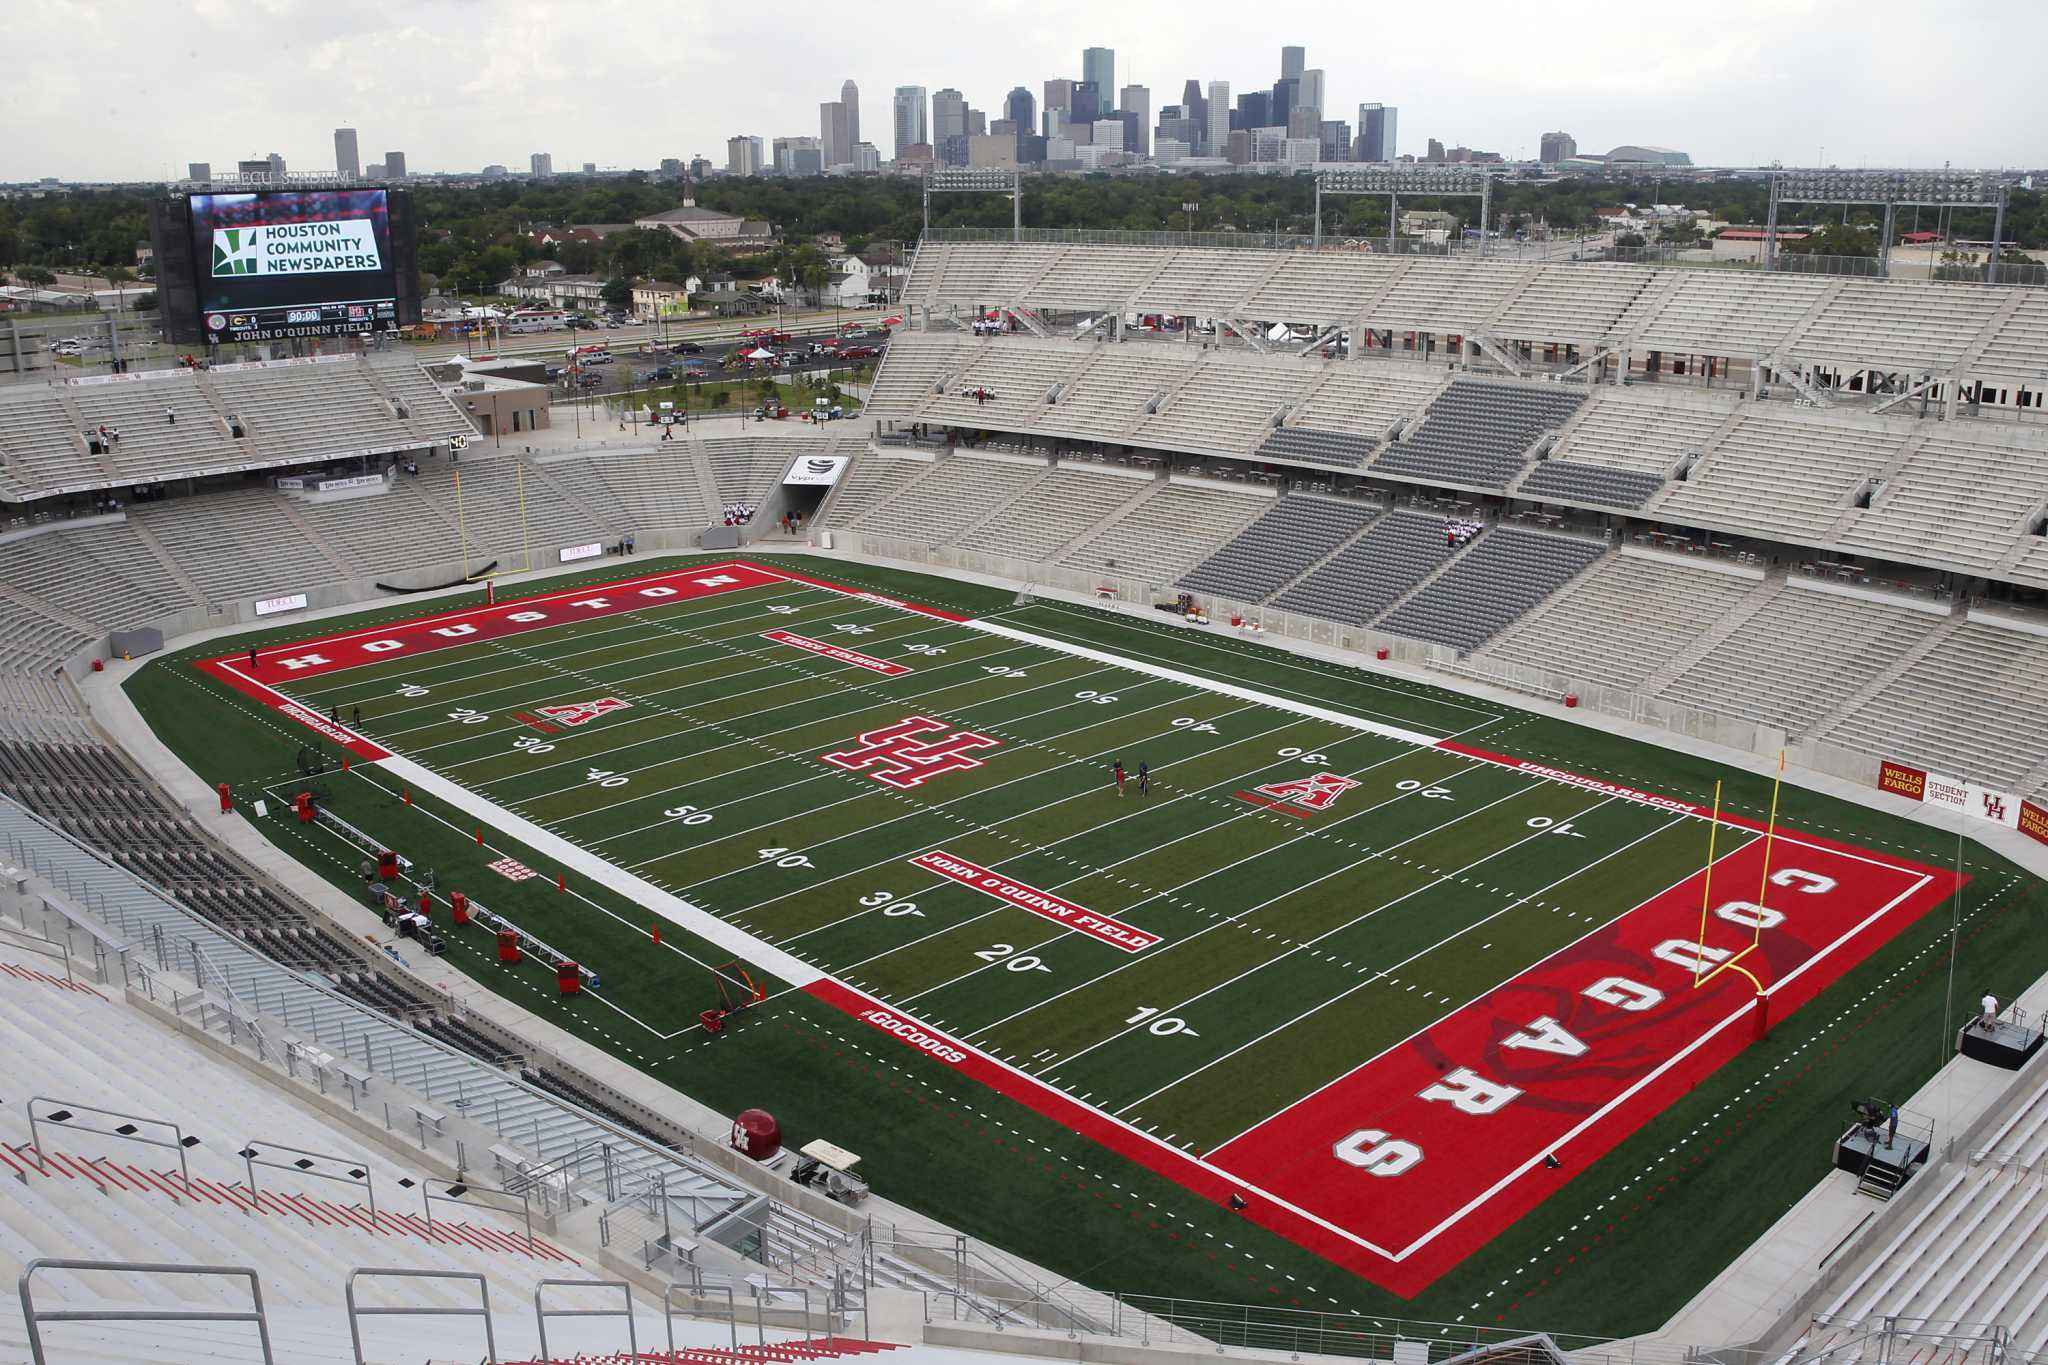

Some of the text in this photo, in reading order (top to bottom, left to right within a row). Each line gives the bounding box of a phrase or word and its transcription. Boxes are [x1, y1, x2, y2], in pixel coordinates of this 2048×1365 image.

[265, 223, 341, 240] HOUSTON
[266, 238, 362, 255] COMMUNITY
[267, 254, 377, 272] NEWSPAPERS
[289, 310, 318, 324] 90:00
[234, 322, 373, 341] JOHN O'QUINN FIELD
[450, 434, 467, 449] 40
[276, 574, 741, 670] HOUSTON
[909, 644, 947, 656] 30
[825, 649, 891, 670] STADIUM
[987, 665, 1028, 678] 40
[396, 683, 430, 698] 10
[1074, 690, 1119, 705] 50
[447, 707, 489, 724] 20
[1171, 717, 1218, 733] 40
[513, 736, 556, 754] 30
[1277, 747, 1328, 764] 30
[586, 769, 629, 788] 40
[1883, 767, 1922, 785] WELLS
[1395, 779, 1452, 799] 20
[1518, 761, 1698, 813] UHCOUGARS.COM
[1883, 777, 1921, 794] FARGO
[1928, 781, 1969, 798] STUDENT
[1928, 789, 1966, 806] SECTION
[664, 804, 713, 826] 50
[1526, 816, 1577, 835] 10
[757, 846, 809, 869] 40
[858, 891, 917, 917] 30
[921, 854, 1150, 950] JOHN O'QUINN FIELD
[973, 943, 1041, 973] 20
[1124, 1006, 1186, 1037] 10
[1332, 868, 1839, 1177] COUGARS
